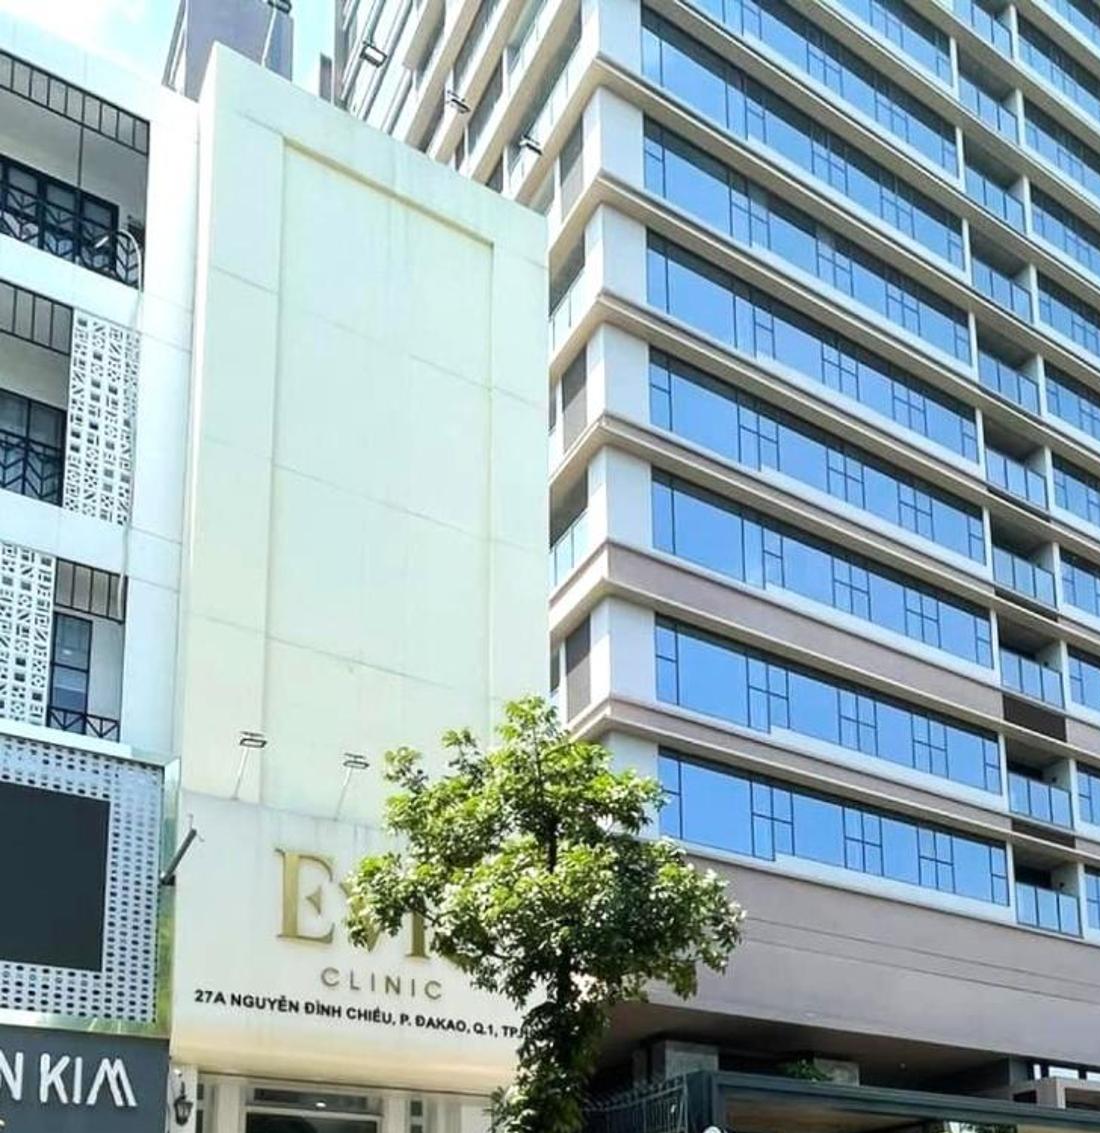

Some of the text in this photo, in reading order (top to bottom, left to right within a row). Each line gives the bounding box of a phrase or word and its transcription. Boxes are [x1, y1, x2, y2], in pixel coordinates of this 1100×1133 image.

[321, 967, 442, 1000] CLINIC
[194, 989, 226, 1006] 27A
[304, 1000, 342, 1019] ĐÌNH
[400, 1013, 412, 1026] P.
[415, 1014, 471, 1034] ĐAKAO,
[39, 1052, 138, 1107] KIM
